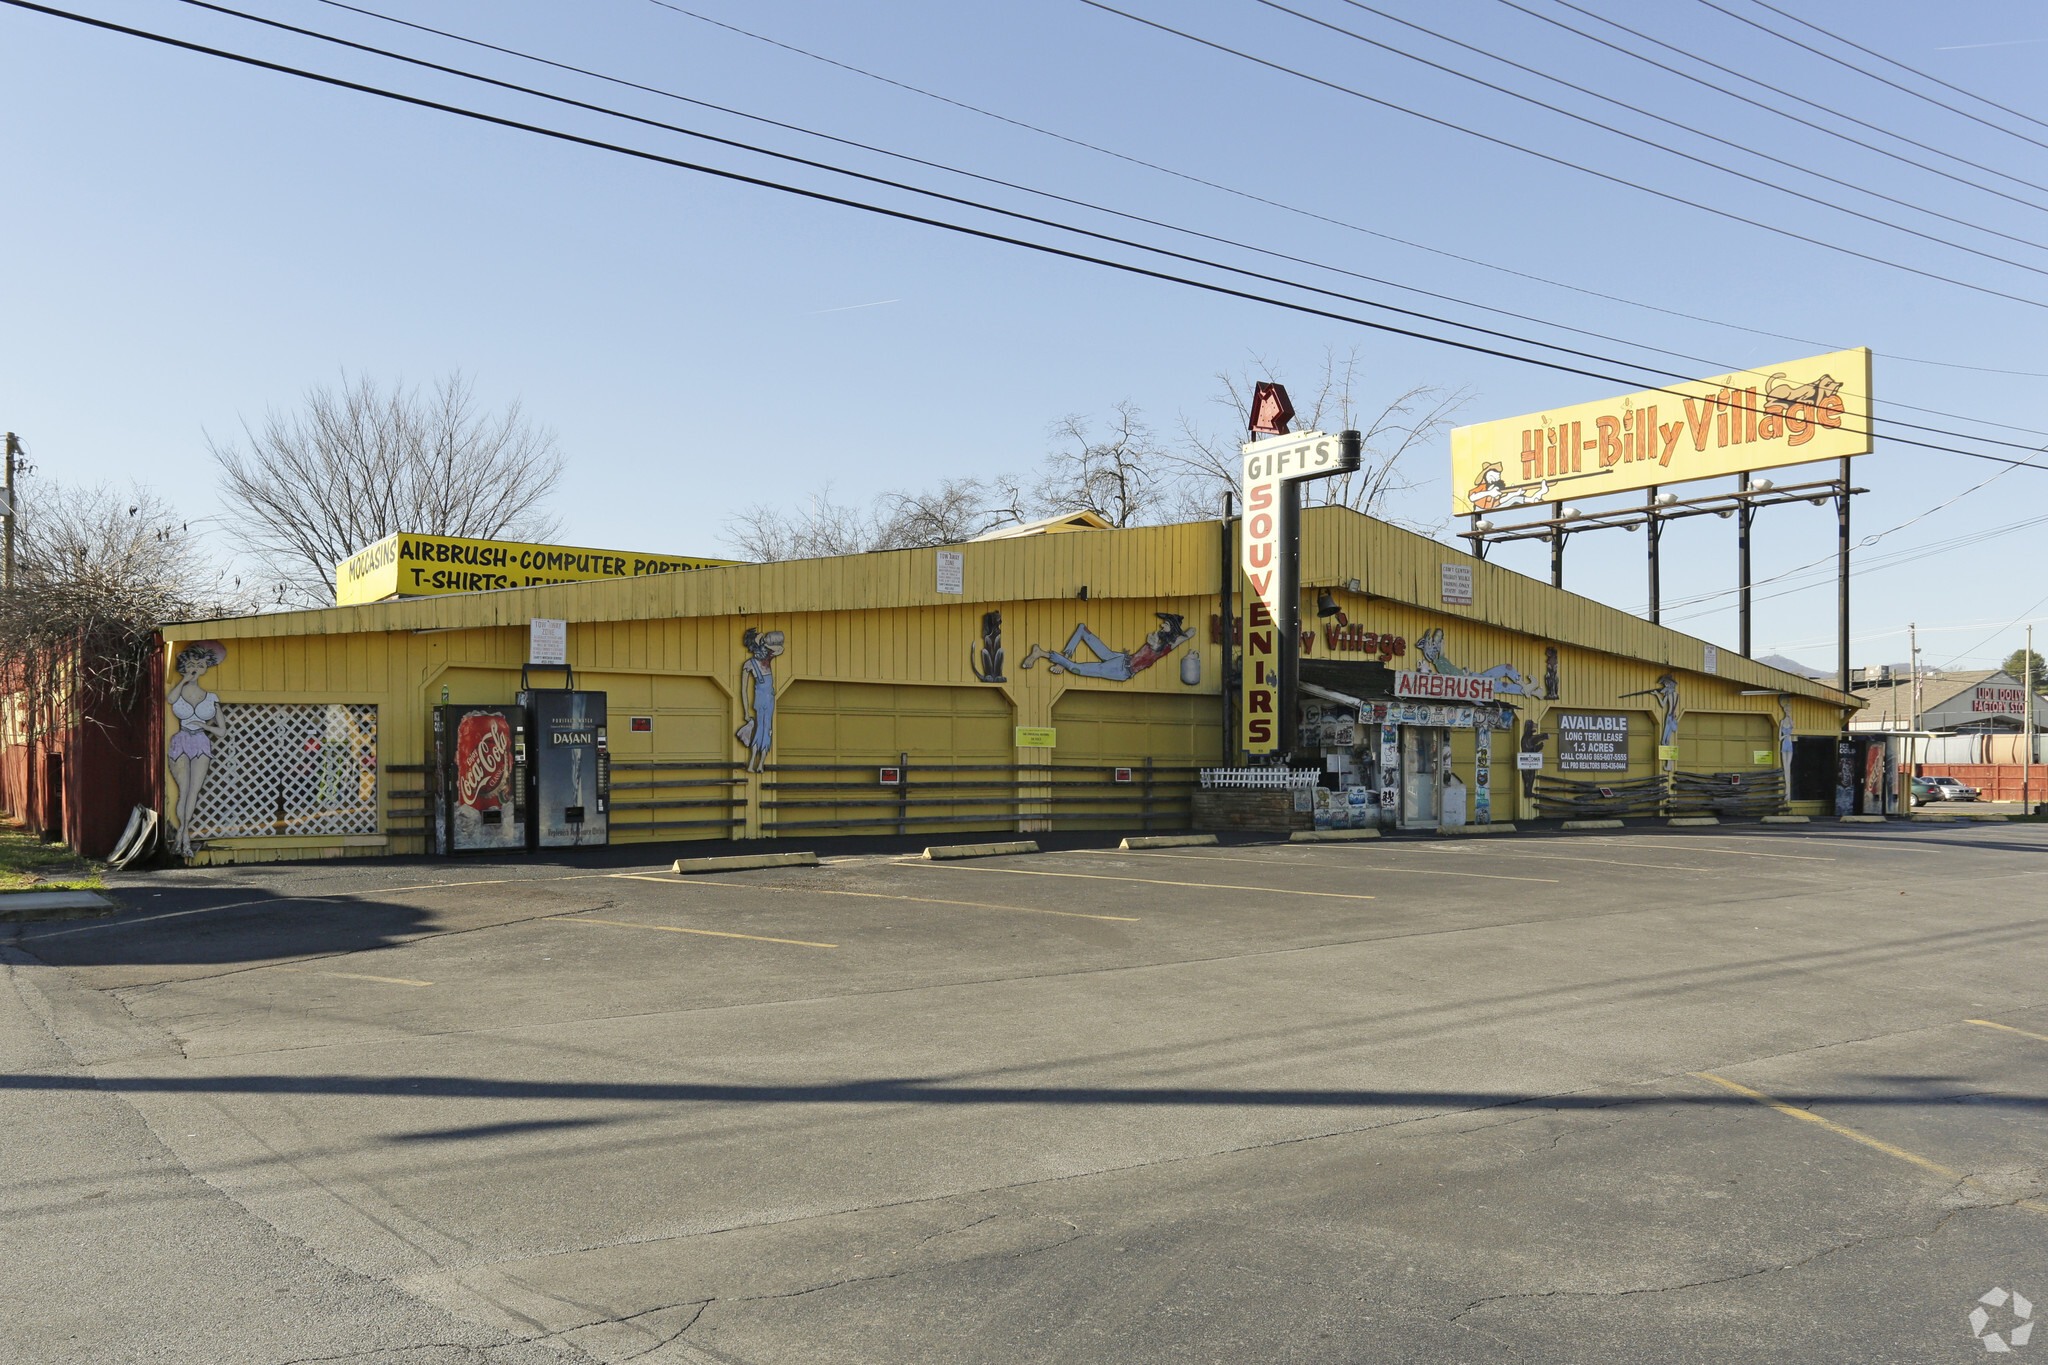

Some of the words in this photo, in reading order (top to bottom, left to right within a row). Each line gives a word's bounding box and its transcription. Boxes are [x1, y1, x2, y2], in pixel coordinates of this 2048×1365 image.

[1520, 404, 1685, 481] Hill-Billy
[1683, 385, 1846, 452] Village
[1248, 441, 1330, 480] GIFTS
[349, 538, 397, 582] MOCCASINS
[400, 540, 507, 568] AIRBRUSH
[519, 550, 627, 576] COMPUTER
[411, 568, 507, 591] T-SHIRTS
[1248, 483, 1273, 743] SOUVENIRS
[1326, 623, 1407, 662] Village
[1399, 673, 1493, 700] AIRBRUSH
[1998, 688, 2026, 701] DOLLY'
[1972, 700, 2007, 713] FACTORY
[2009, 701, 2026, 714] STO
[1560, 715, 1627, 731] AVAILABLE
[553, 732, 592, 745] DASANI
[1565, 731, 1583, 741] LONG
[1584, 732, 1602, 742] TERM
[1603, 732, 1623, 742] LEASE
[467, 748, 479, 767] Enjoy
[1560, 752, 1575, 760] CALL
[1575, 753, 1593, 761] CRAIG
[1573, 742, 1586, 752] 1.3
[1588, 742, 1614, 753] ACRES
[461, 719, 508, 806] Coca-Cola
[1561, 761, 1570, 769] ALL
[1570, 761, 1579, 769] PRO
[1579, 761, 1601, 770] REALTORS
